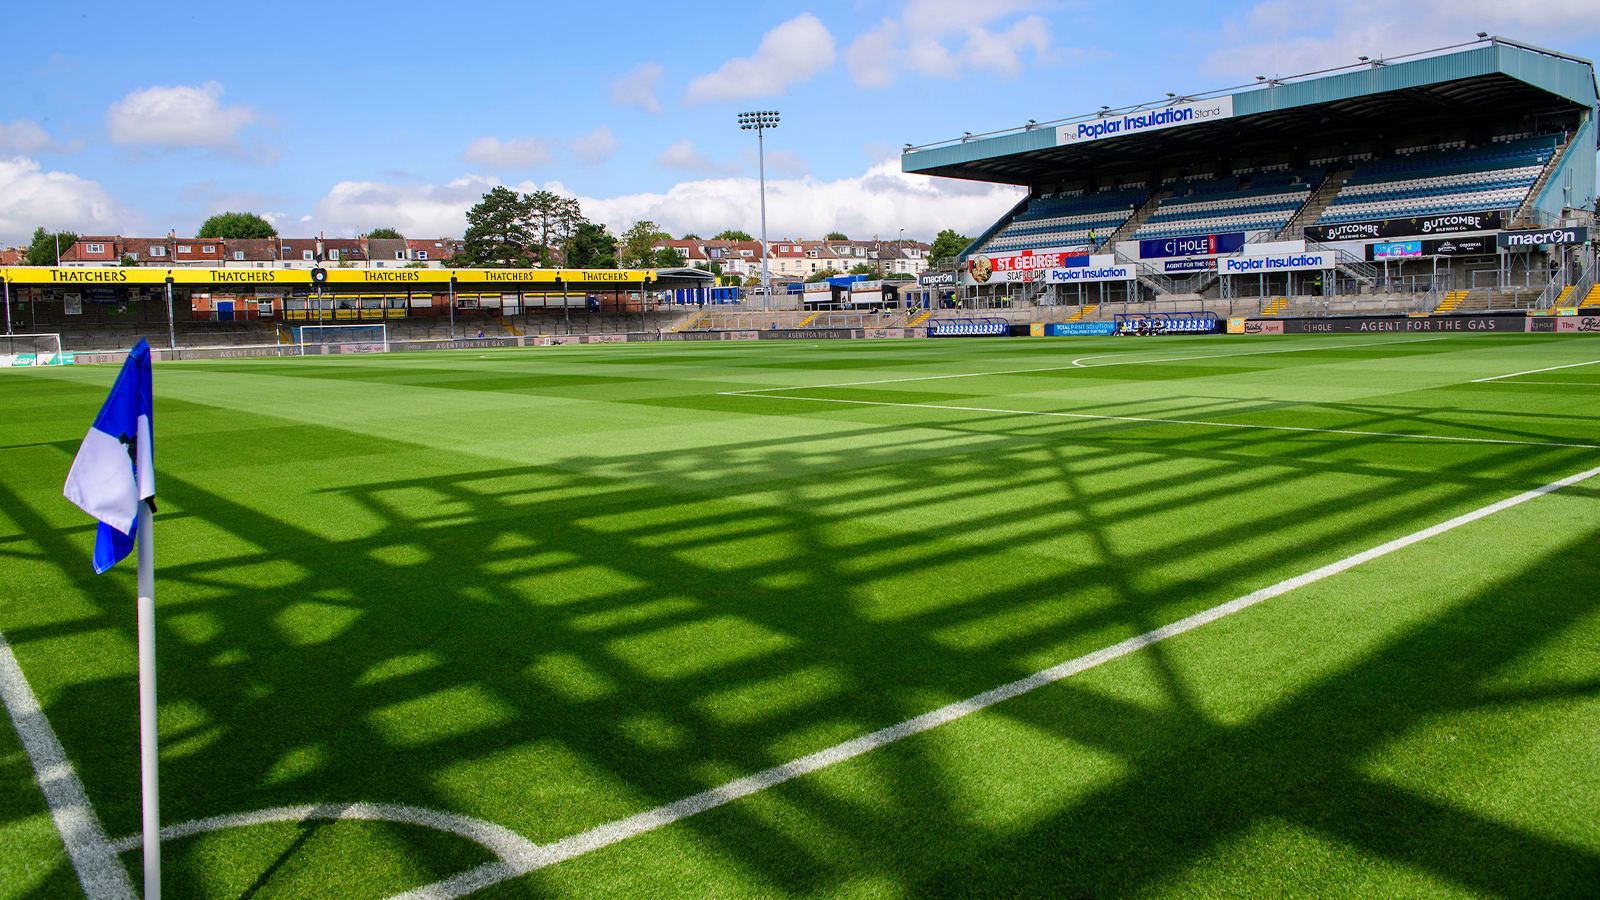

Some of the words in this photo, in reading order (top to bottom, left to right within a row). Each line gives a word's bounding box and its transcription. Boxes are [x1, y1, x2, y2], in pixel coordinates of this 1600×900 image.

[1064, 132, 1076, 140] The
[1078, 120, 1122, 138] Poplar
[1124, 108, 1192, 130] Insulation
[1195, 106, 1220, 118] Stand
[1422, 216, 1482, 232] BUTCOMBE
[1327, 224, 1379, 240] BUTCOMBE
[1508, 231, 1575, 244] macron
[1180, 240, 1208, 251] HOLE
[998, 257, 1012, 270] ST.
[1014, 253, 1060, 270] GEORGE
[1227, 258, 1264, 272] Poplar
[1266, 255, 1322, 268] Insulation
[50, 270, 126, 282] THATCHERS
[210, 270, 274, 282] THATCHERS
[363, 270, 418, 281] THATCHERS
[484, 271, 533, 281] THATCHERS
[582, 272, 628, 281] THATCHERS
[923, 274, 952, 283] macron
[1006, 269, 1046, 280] SCAFFOLDIN
[1052, 270, 1080, 282] Poplar
[1082, 267, 1126, 279] Insulation
[1313, 324, 1332, 332] HOLE
[1361, 322, 1400, 330] AGENT
[1407, 321, 1430, 330] FOR
[1437, 321, 1461, 329] THE
[1468, 320, 1495, 329] GAS
[271, 348, 285, 356] THE
